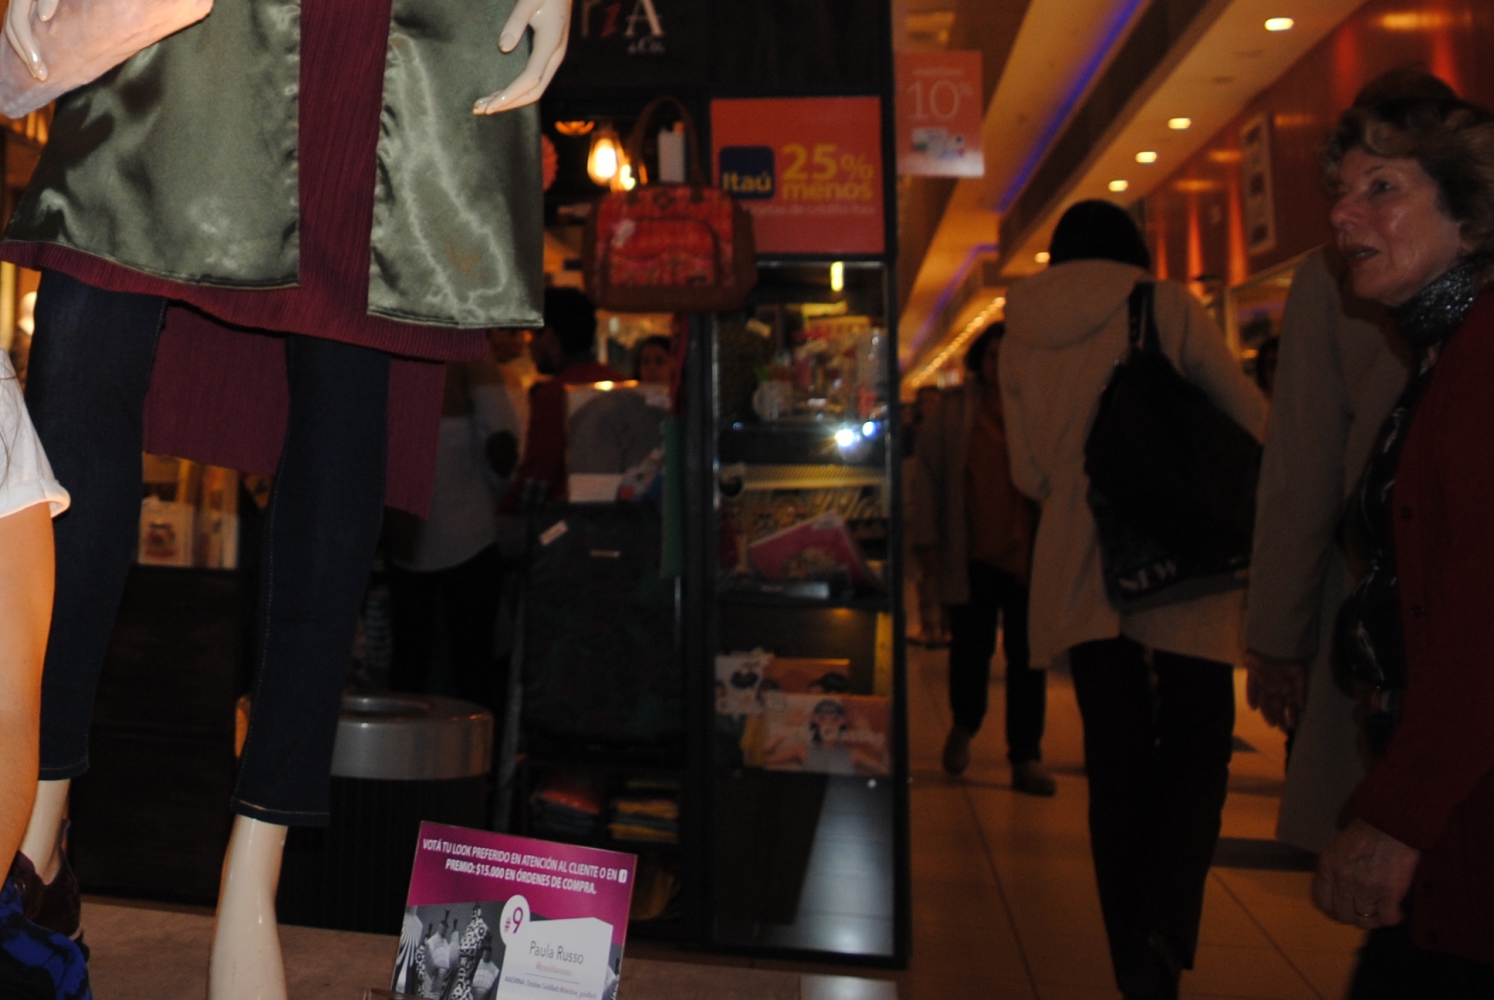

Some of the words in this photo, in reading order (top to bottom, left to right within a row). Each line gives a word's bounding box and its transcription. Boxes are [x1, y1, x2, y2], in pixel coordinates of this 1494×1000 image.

[781, 143, 875, 182] 25%
[721, 169, 772, 193] Itaú
[782, 181, 874, 200] menos
[423, 838, 442, 851] VOTÁ
[442, 841, 452, 853] TU
[452, 843, 472, 857] LOOK
[471, 846, 511, 863] PREFERIDO
[510, 852, 522, 865] EN
[521, 855, 558, 870] ATENCIÓN
[558, 861, 567, 873] AL
[568, 862, 599, 878] CLIENTE
[599, 867, 606, 879] O
[606, 868, 618, 881] EN
[445, 858, 476, 874] PREMIO:
[475, 863, 504, 879] $15.000
[504, 868, 516, 881] EN
[516, 868, 550, 887] ÓRDENES
[550, 876, 562, 889] DE
[562, 878, 597, 895] COMPRA.
[529, 940, 554, 959] Paula
[556, 945, 584, 964] Russo
